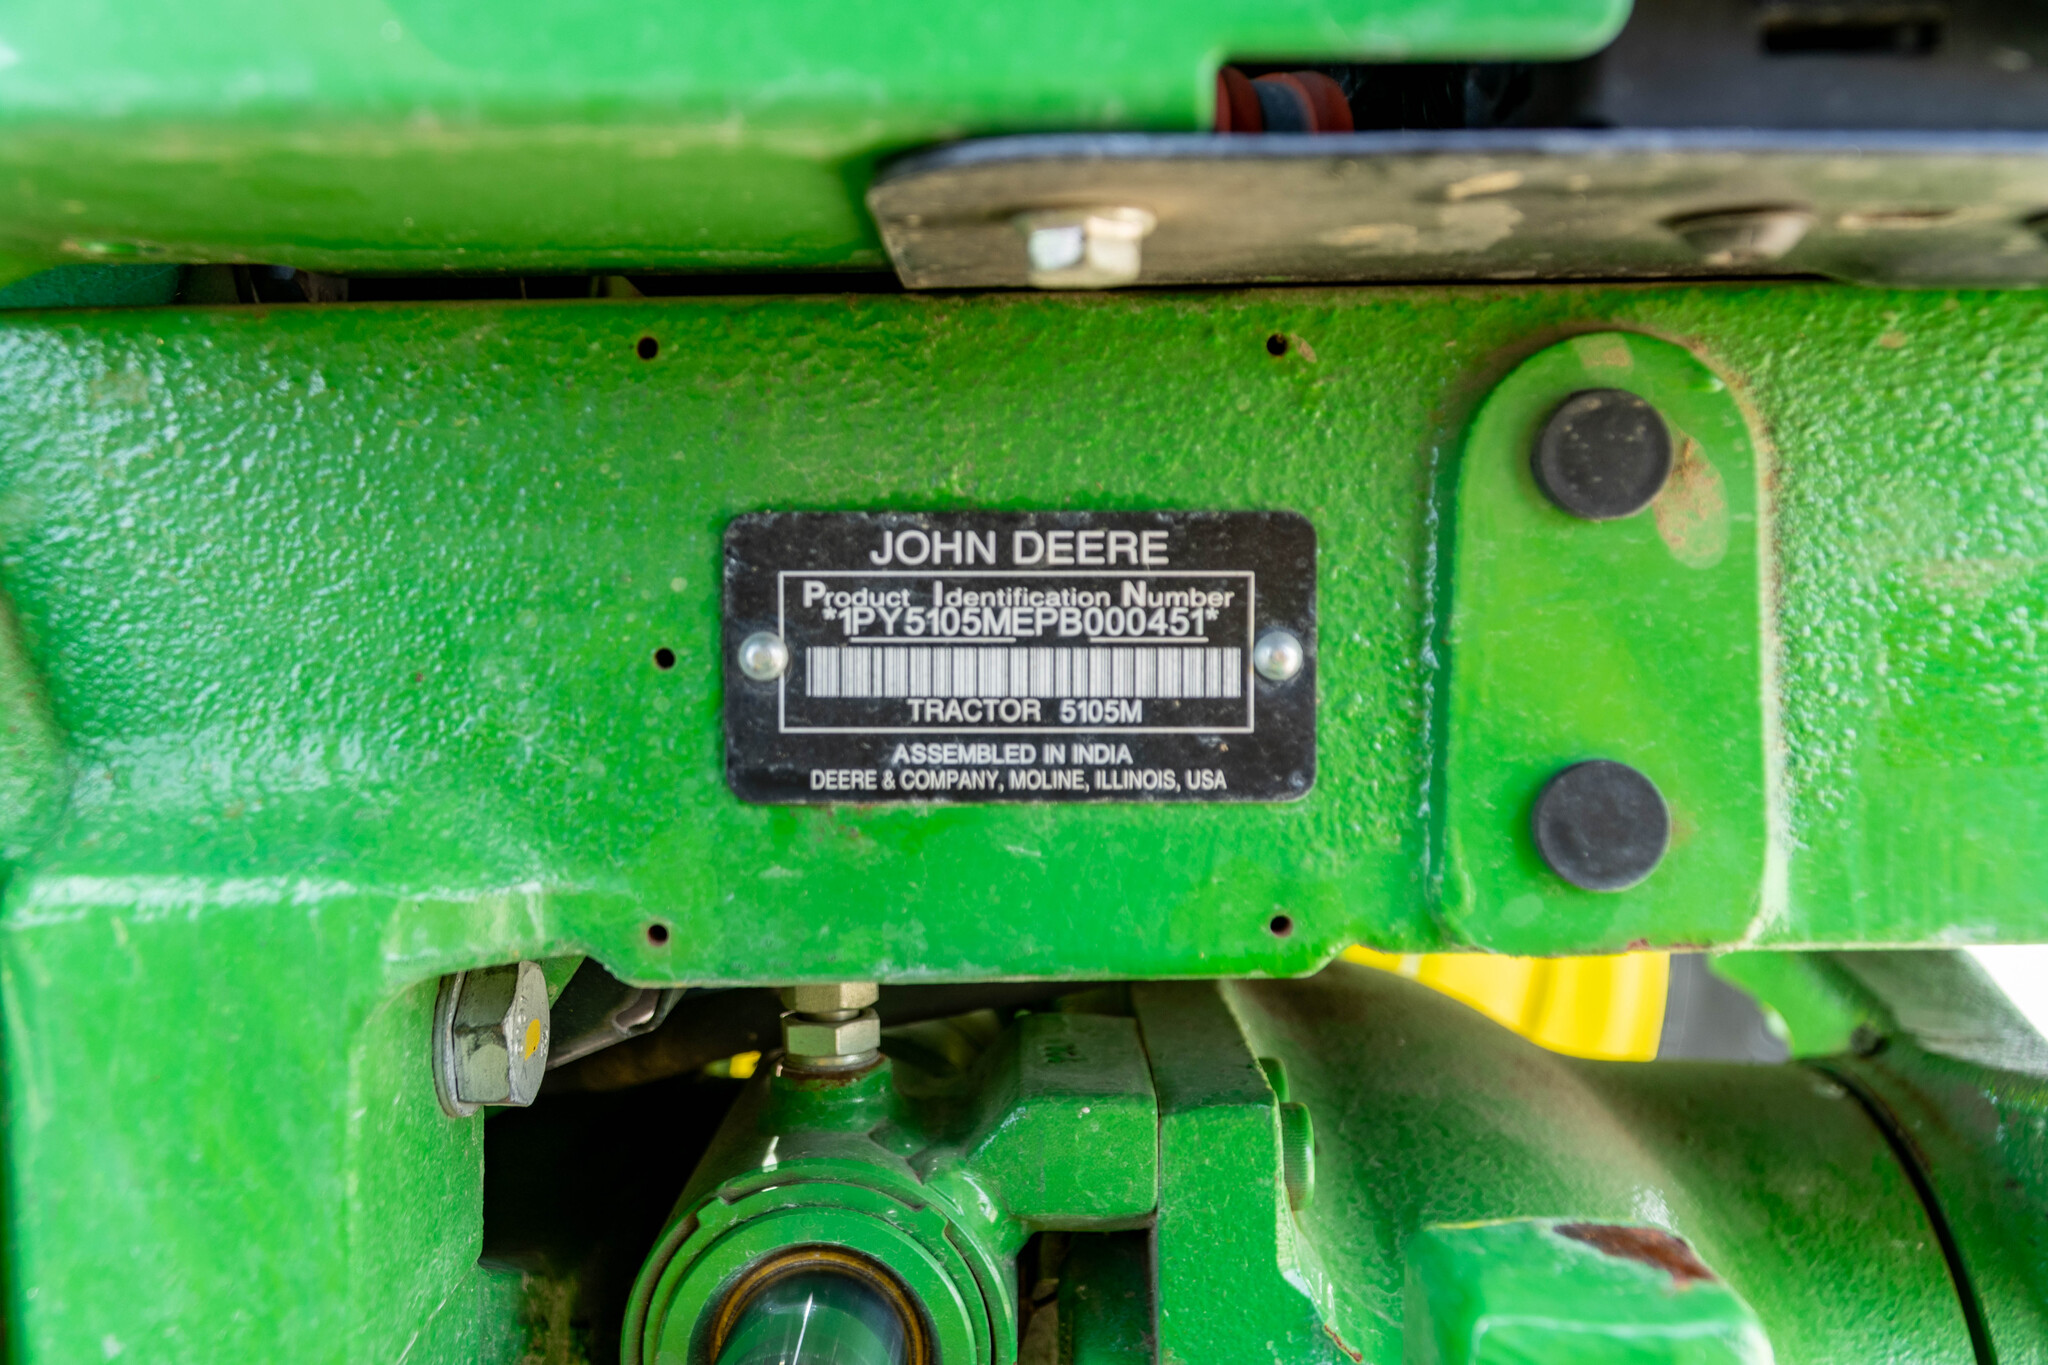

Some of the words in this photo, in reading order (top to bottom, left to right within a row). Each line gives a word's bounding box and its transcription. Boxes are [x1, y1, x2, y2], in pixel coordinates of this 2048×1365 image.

[869, 530, 996, 565] JOHN
[1013, 530, 1170, 565] DEERE
[803, 580, 910, 607] Product
[933, 580, 1111, 607] Identification
[1121, 580, 1235, 607] Number
[907, 699, 1041, 723] TRACTOR
[1059, 699, 1143, 724] 5105M
[892, 743, 1037, 765] ASSEMBLED
[1043, 744, 1065, 765] IN
[1071, 744, 1133, 765] INDIA
[811, 769, 878, 790] DEERE
[882, 769, 896, 790] &
[900, 769, 1004, 793] COMPANY,
[1009, 769, 1089, 793] MOLINE,
[1094, 769, 1181, 793] ILLINOIS,
[1185, 769, 1227, 790] USA
